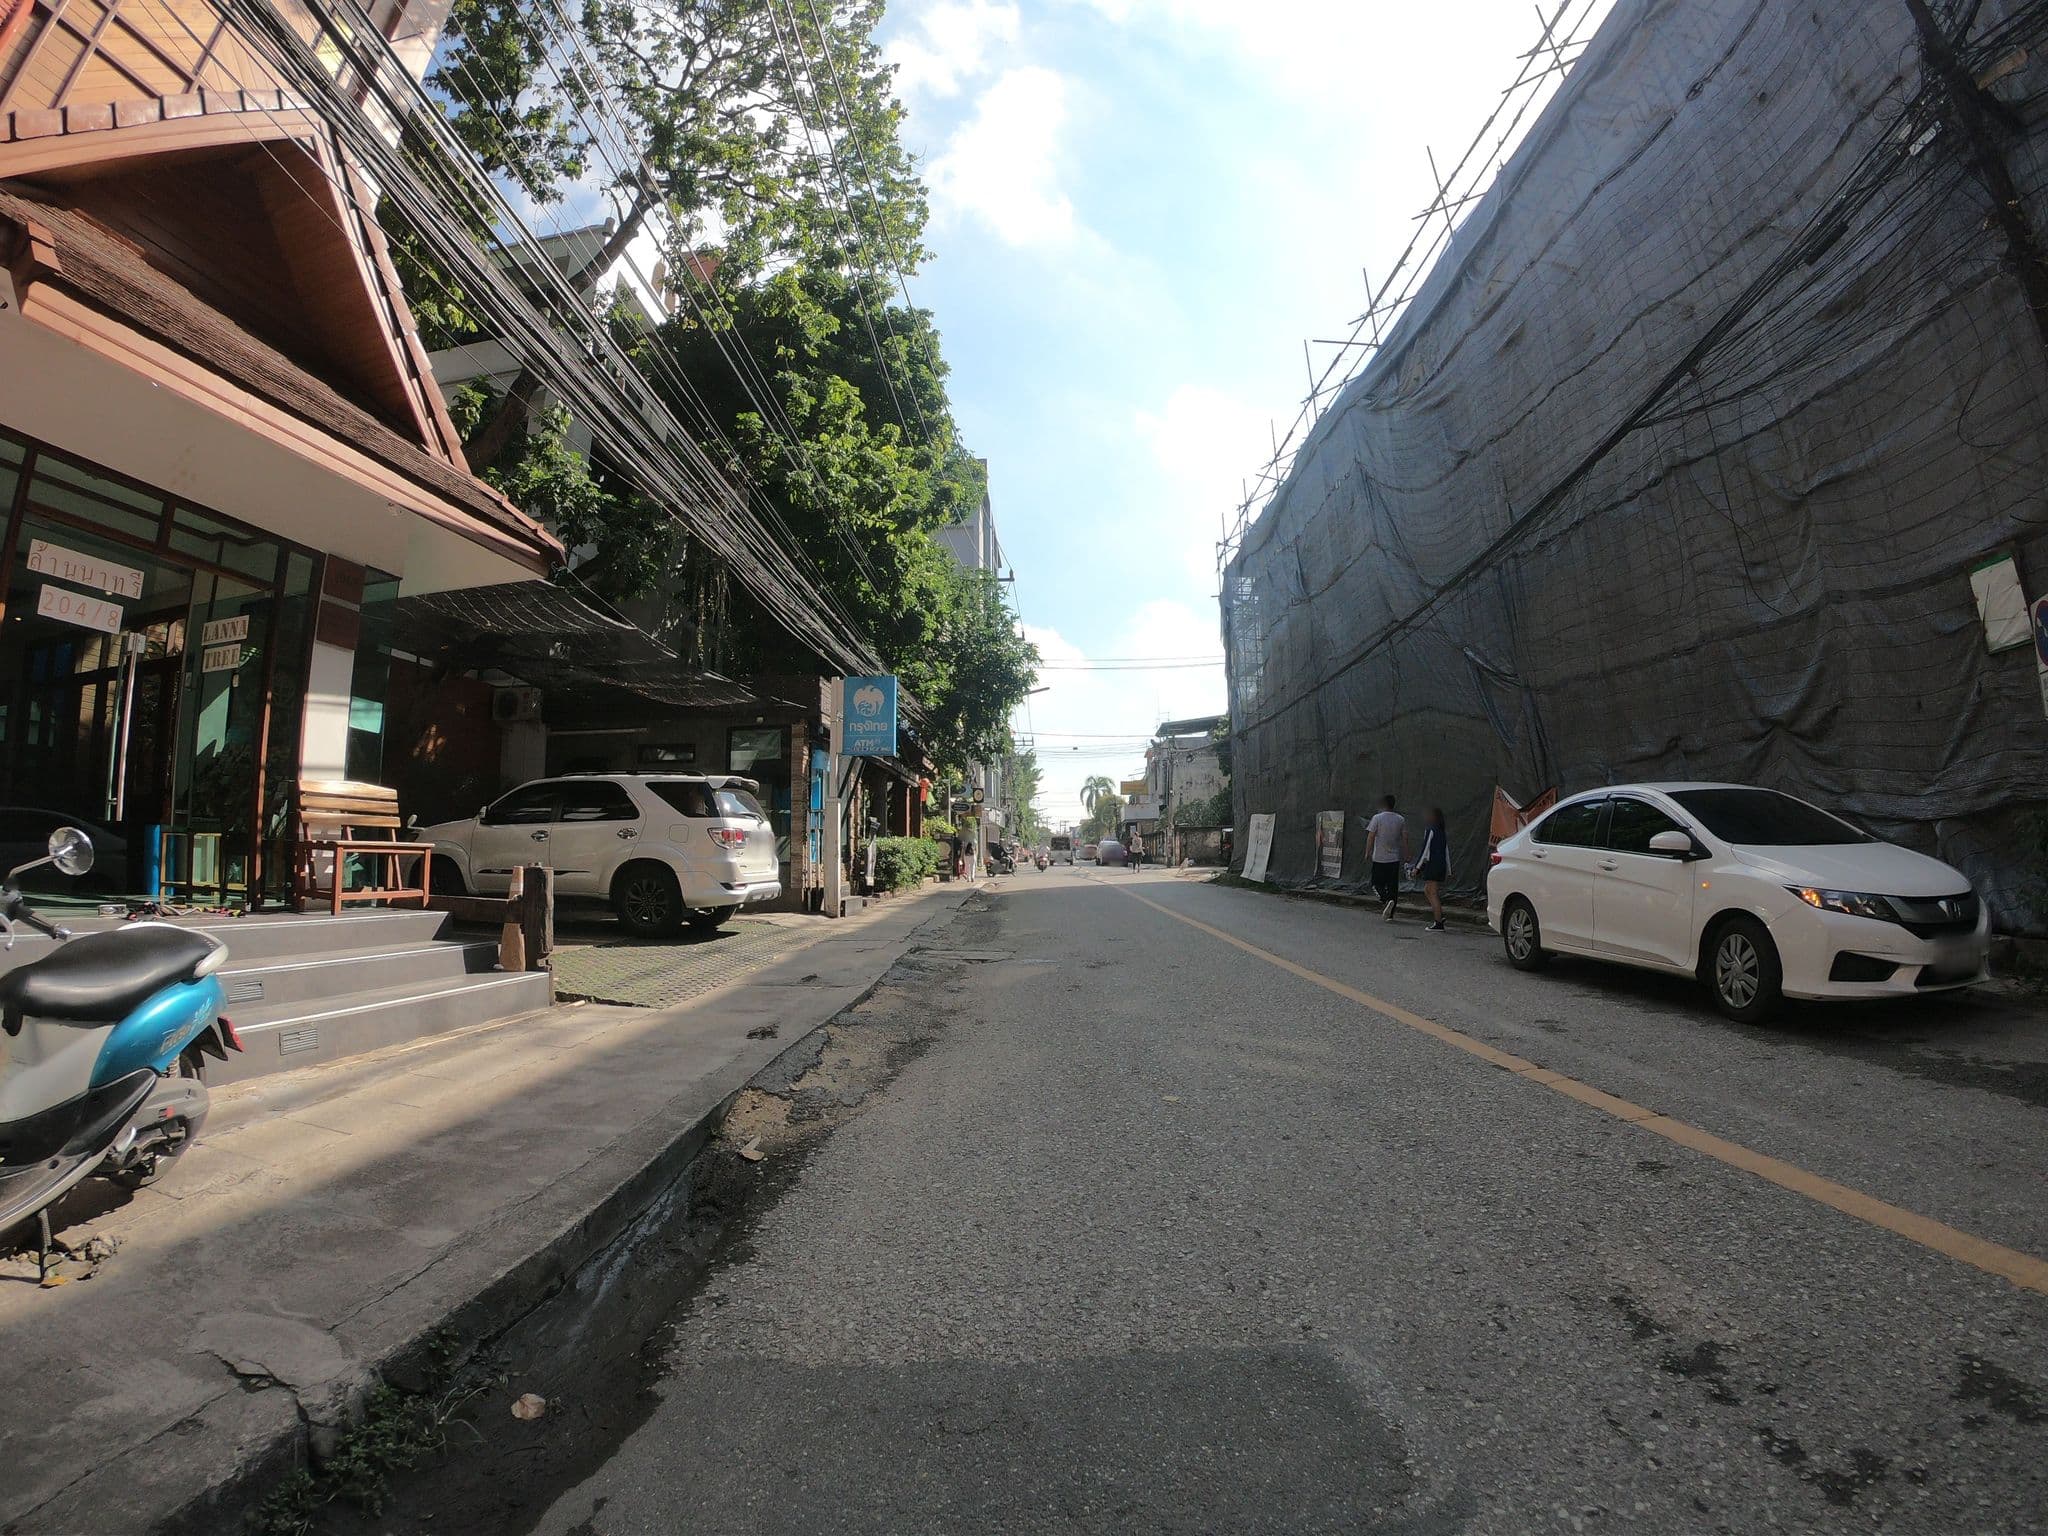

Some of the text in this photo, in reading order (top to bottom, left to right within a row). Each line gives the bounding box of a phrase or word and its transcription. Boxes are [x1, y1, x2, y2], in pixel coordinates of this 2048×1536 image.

[42, 591, 119, 628] 204/8
[203, 619, 248, 643] LANNA
[204, 648, 240, 669] TREE
[849, 719, 888, 734] กรุงไทย
